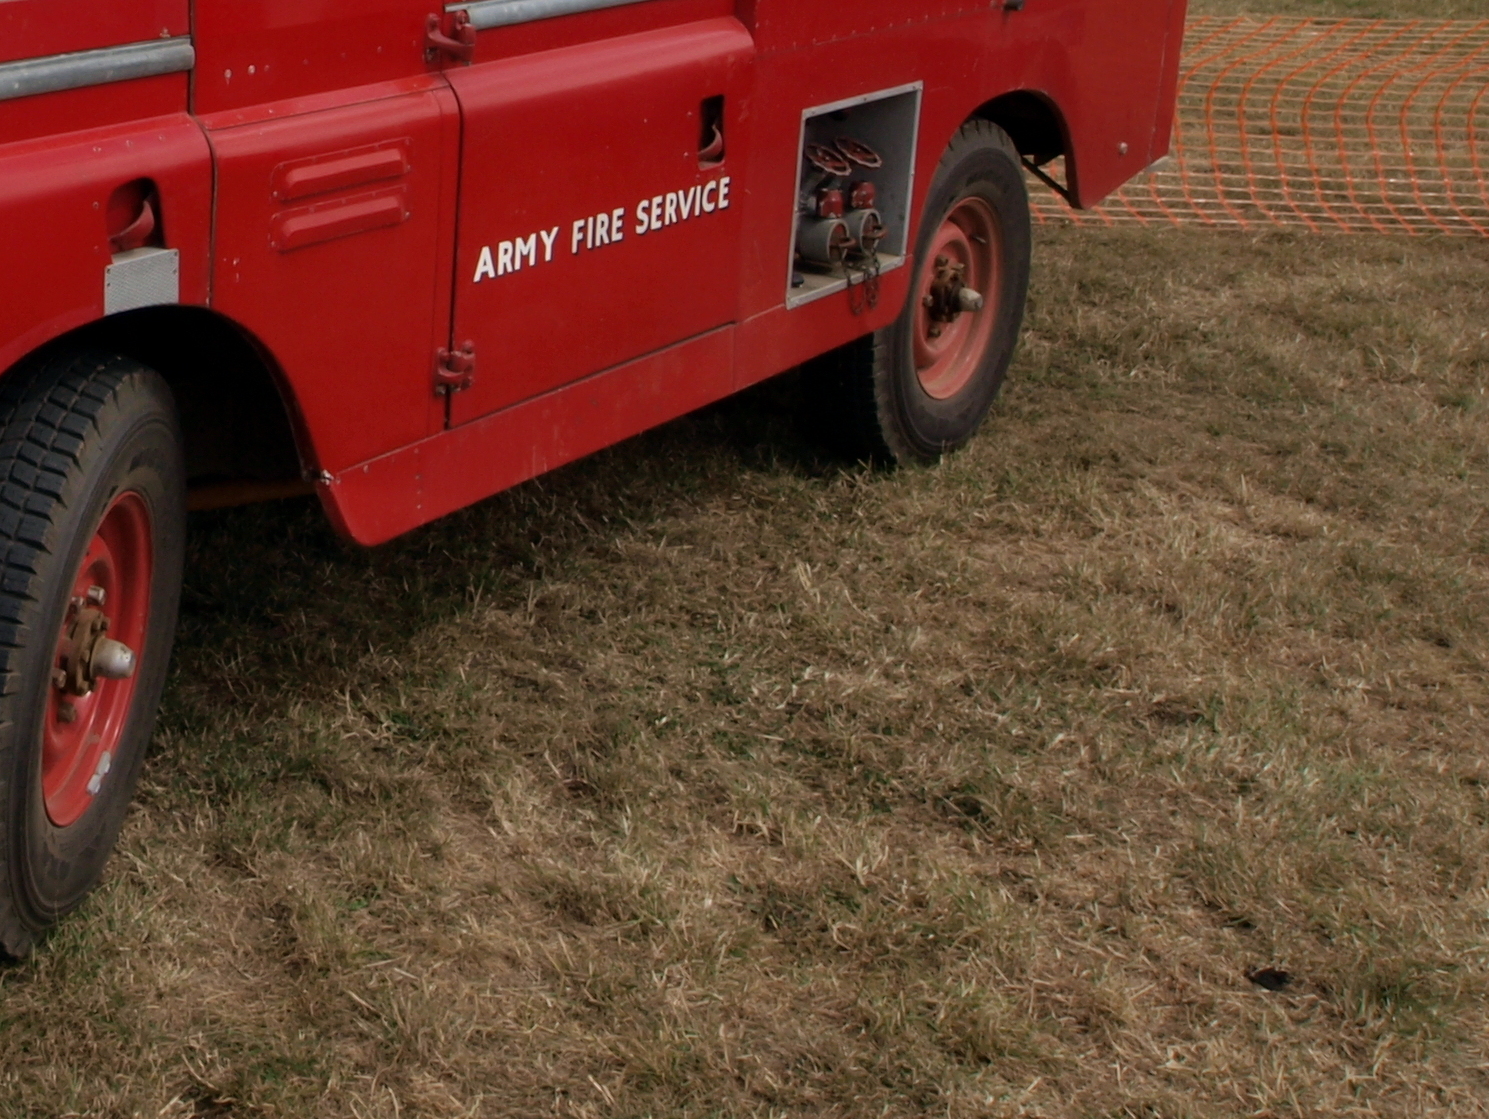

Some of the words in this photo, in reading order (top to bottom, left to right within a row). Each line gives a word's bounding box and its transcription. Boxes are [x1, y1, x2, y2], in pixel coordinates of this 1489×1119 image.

[473, 226, 560, 283] ARMY
[571, 207, 625, 255] FIRE
[635, 176, 731, 236] SERVICE
